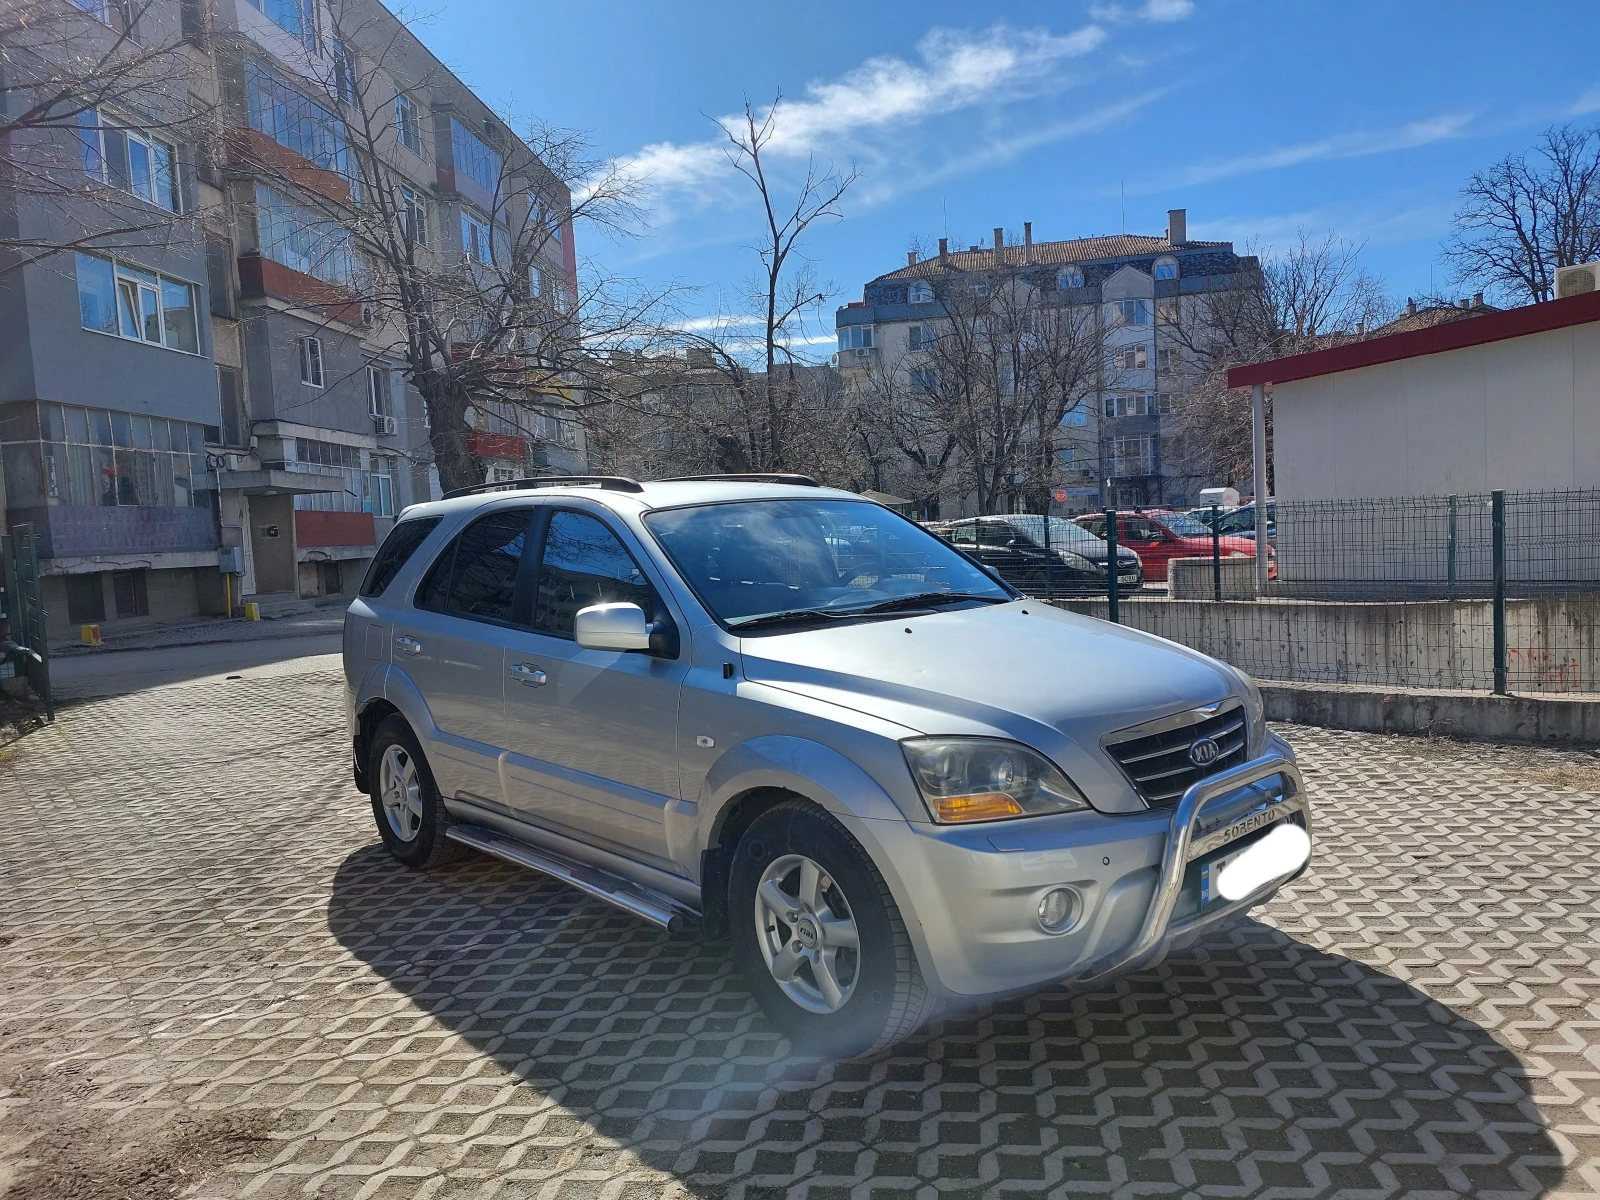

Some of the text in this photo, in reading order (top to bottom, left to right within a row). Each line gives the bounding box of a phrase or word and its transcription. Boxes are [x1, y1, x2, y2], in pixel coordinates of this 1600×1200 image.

[1195, 744, 1216, 762] KIA
[1223, 809, 1275, 842] SORENTO
[1201, 888, 1209, 900] BG
